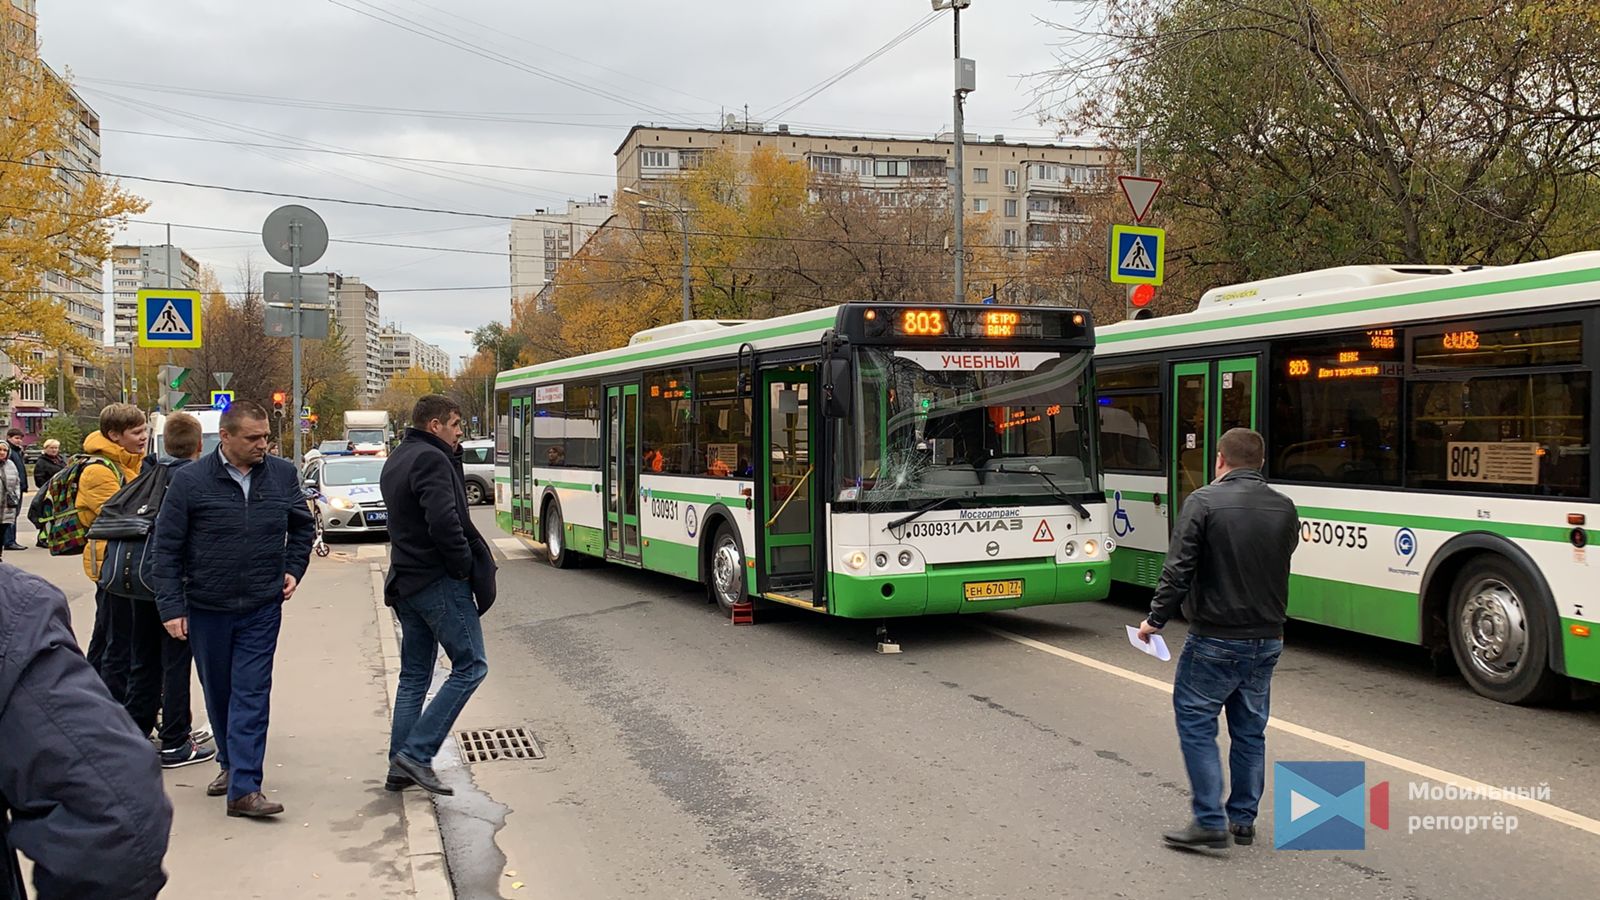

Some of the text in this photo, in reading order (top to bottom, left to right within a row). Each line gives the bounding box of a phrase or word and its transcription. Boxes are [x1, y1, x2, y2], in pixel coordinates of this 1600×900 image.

[904, 312, 942, 334] 803
[987, 313, 1017, 325] МЕТРО
[987, 324, 1011, 336] ВДНХ
[941, 352, 1020, 369] УЧЕБНЫЙ
[1289, 359, 1310, 375] 803
[1451, 446, 1480, 477] 803
[651, 498, 679, 521] 030931
[959, 509, 1020, 519] Мосгортранс
[912, 522, 957, 537] 030931
[957, 519, 1023, 534] ЛИАЗ
[1301, 521, 1368, 550] 030935
[970, 581, 1019, 596] ЕН 670 77
